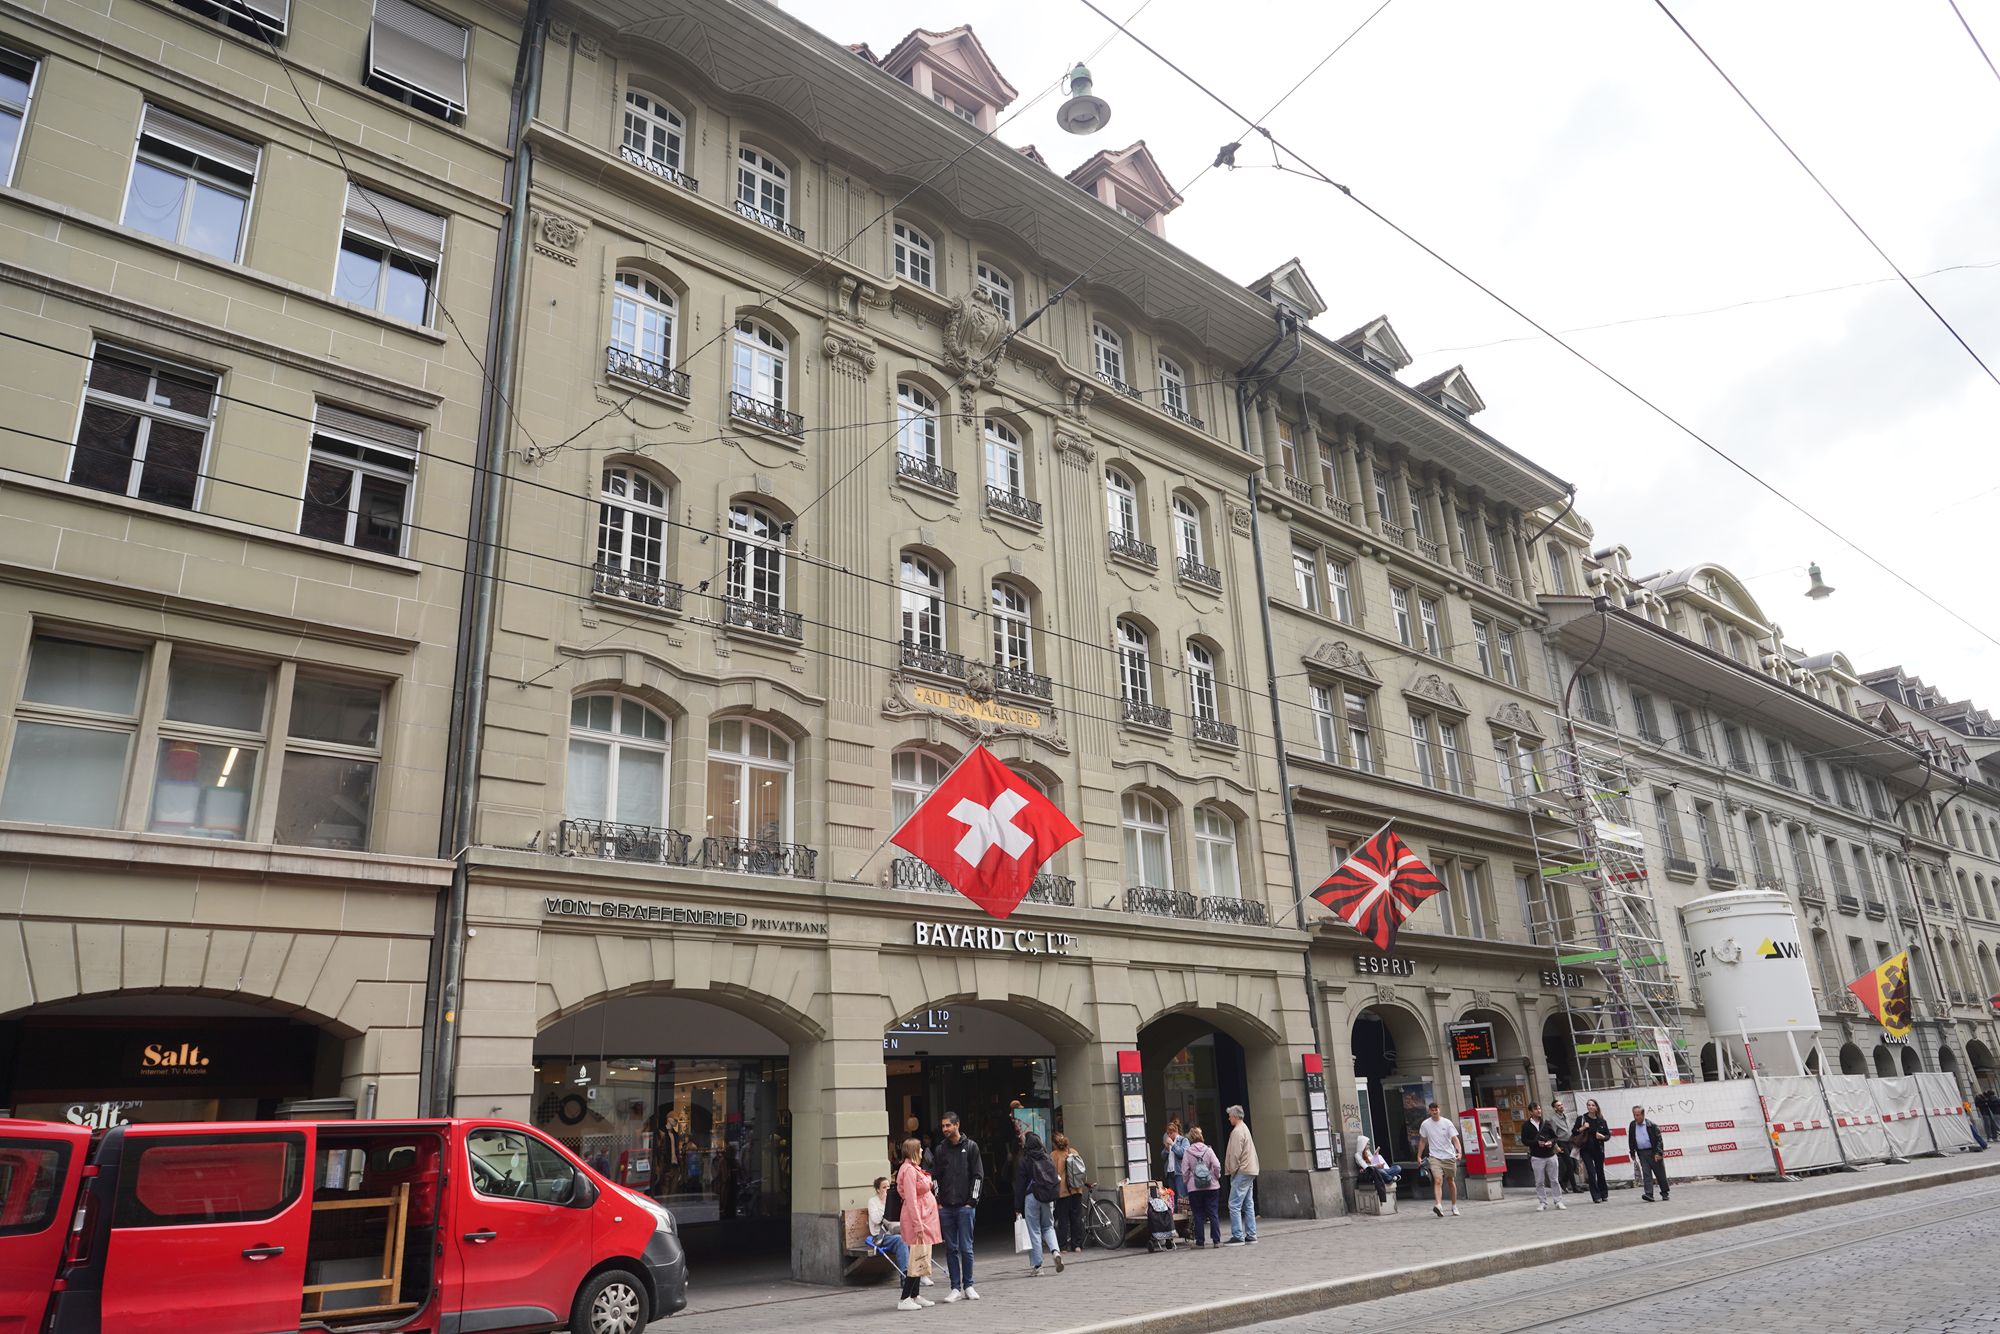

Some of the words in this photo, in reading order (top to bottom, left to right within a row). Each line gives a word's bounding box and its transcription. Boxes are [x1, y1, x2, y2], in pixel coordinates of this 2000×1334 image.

[923, 689, 942, 706] AU
[947, 695, 976, 713] BON
[545, 897, 591, 916] VON
[600, 901, 748, 928] GRAFFENRIED
[751, 918, 829, 935] PRIVATBANK
[915, 921, 1005, 950] BAYARD
[1359, 956, 1416, 976] ESPRIT
[1543, 971, 1585, 988] ESPRIT
[142, 1043, 210, 1067] Salt.
[66, 1101, 129, 1130] Salt.
[1706, 1121, 1734, 1129] HERZOG
[1708, 1143, 1736, 1152] HERZOG
